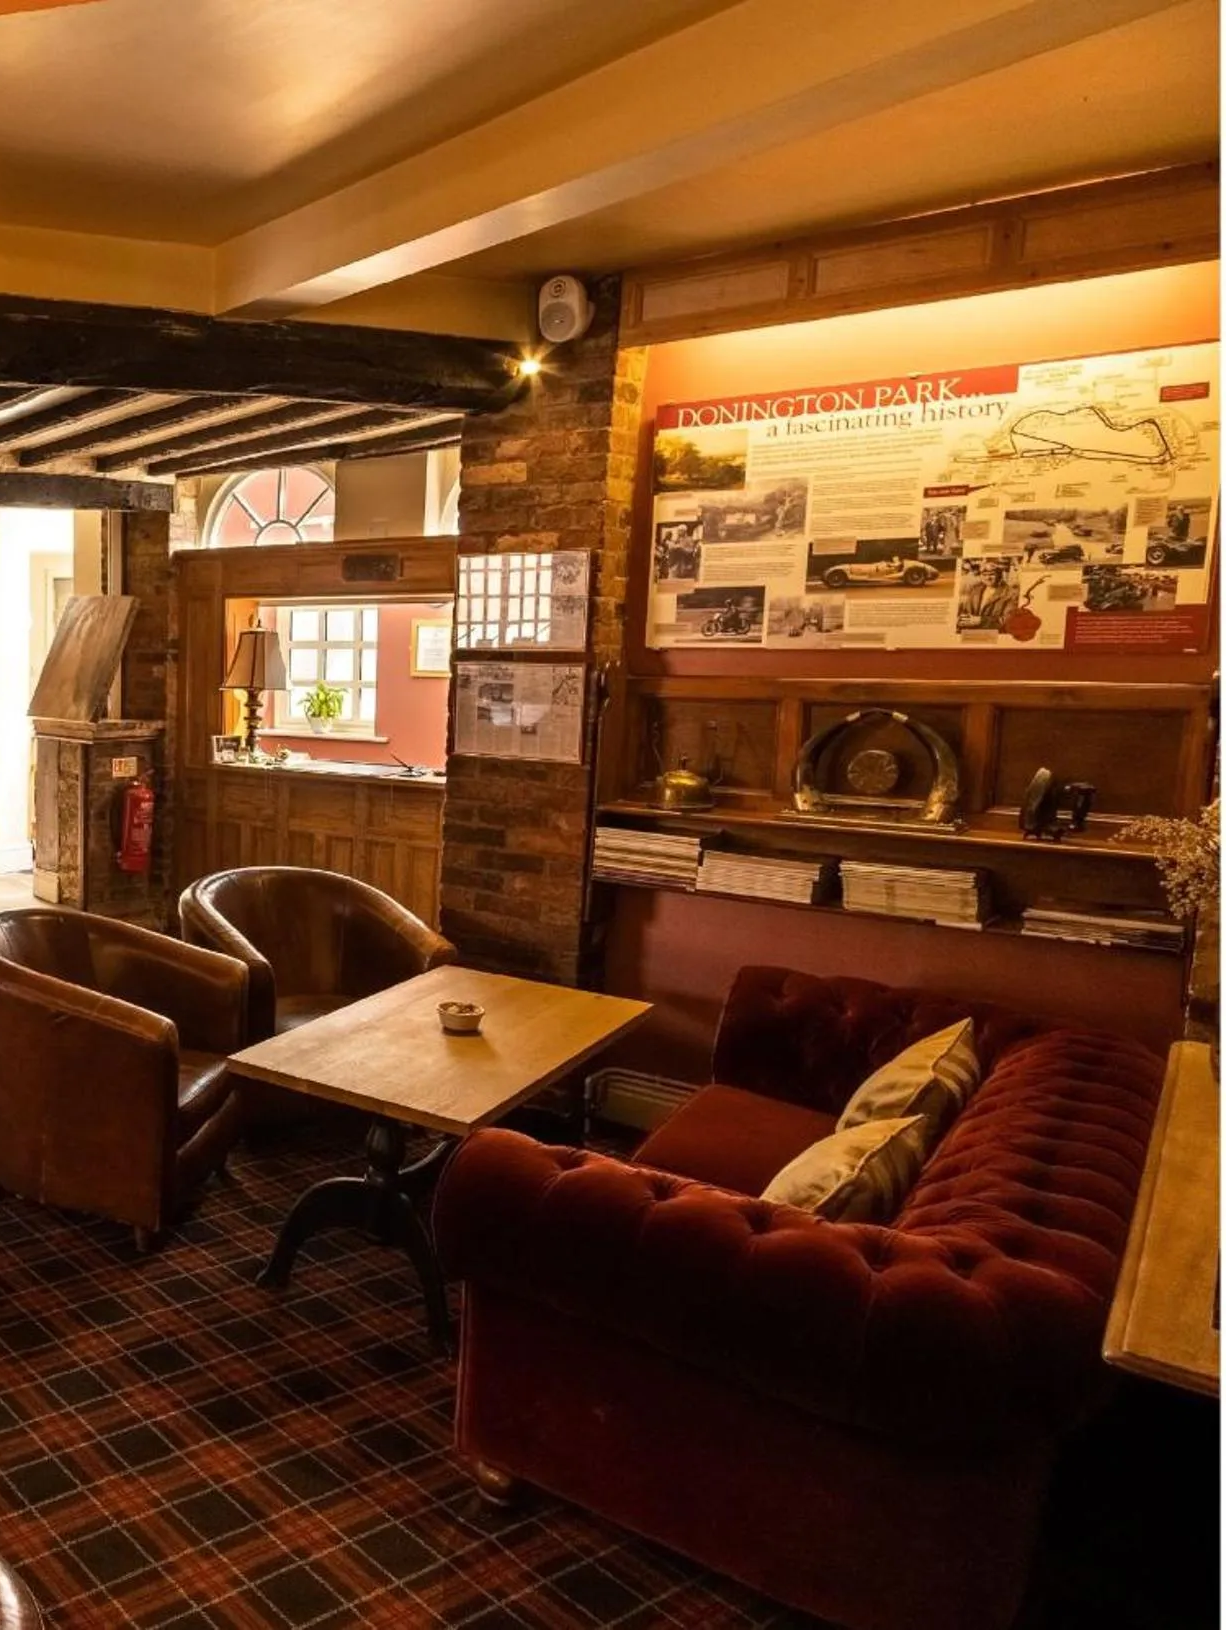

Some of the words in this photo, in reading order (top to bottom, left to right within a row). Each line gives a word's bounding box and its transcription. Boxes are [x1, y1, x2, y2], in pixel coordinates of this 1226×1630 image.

[678, 388, 863, 428] DONINGTON
[767, 425, 778, 437] a
[786, 408, 912, 436] fascinating
[921, 400, 1009, 422] history
